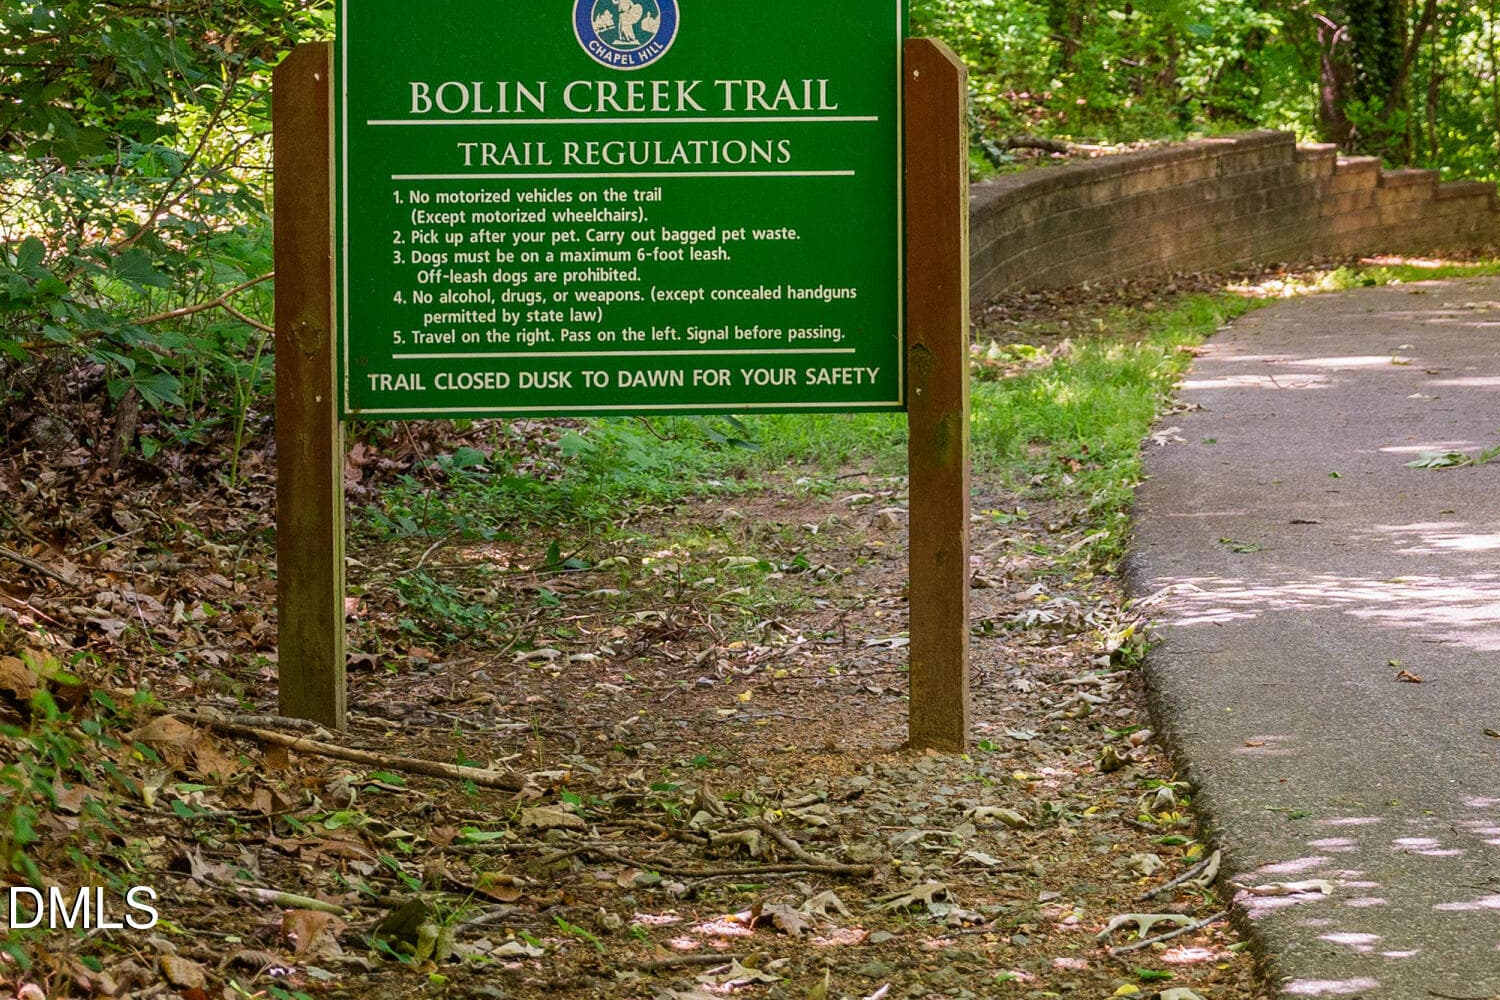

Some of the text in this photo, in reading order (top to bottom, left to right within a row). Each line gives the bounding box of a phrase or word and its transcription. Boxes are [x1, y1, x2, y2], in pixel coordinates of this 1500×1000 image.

[588, 39, 664, 65] CHAPEL HILL
[409, 79, 838, 114] BOLIN CREEK TRAIL
[457, 139, 791, 166] TRAIL REGULATIONS
[393, 186, 662, 204] 1. No motorized vehicles on the trail
[411, 206, 648, 228] (Except motorized wheelchairs).
[392, 226, 801, 247] 2. Pick up after your pet. Carry out bagged pet waste.
[392, 245, 731, 268] 3. Dogs must be on a maximum 6-foot leash.
[417, 266, 641, 287] Off-leash dogs are prohibited.
[393, 284, 857, 307] 4. No alcohol, drugs, or weapons. (except concealed handguns
[423, 306, 603, 327] permitted by state law)
[393, 324, 845, 347] 5. Travel on the right. Pass on the left. Signal before passing.
[367, 367, 880, 391] TRAIL CLOSED DUSK TO DAWN FOR YOUR SAFETY
